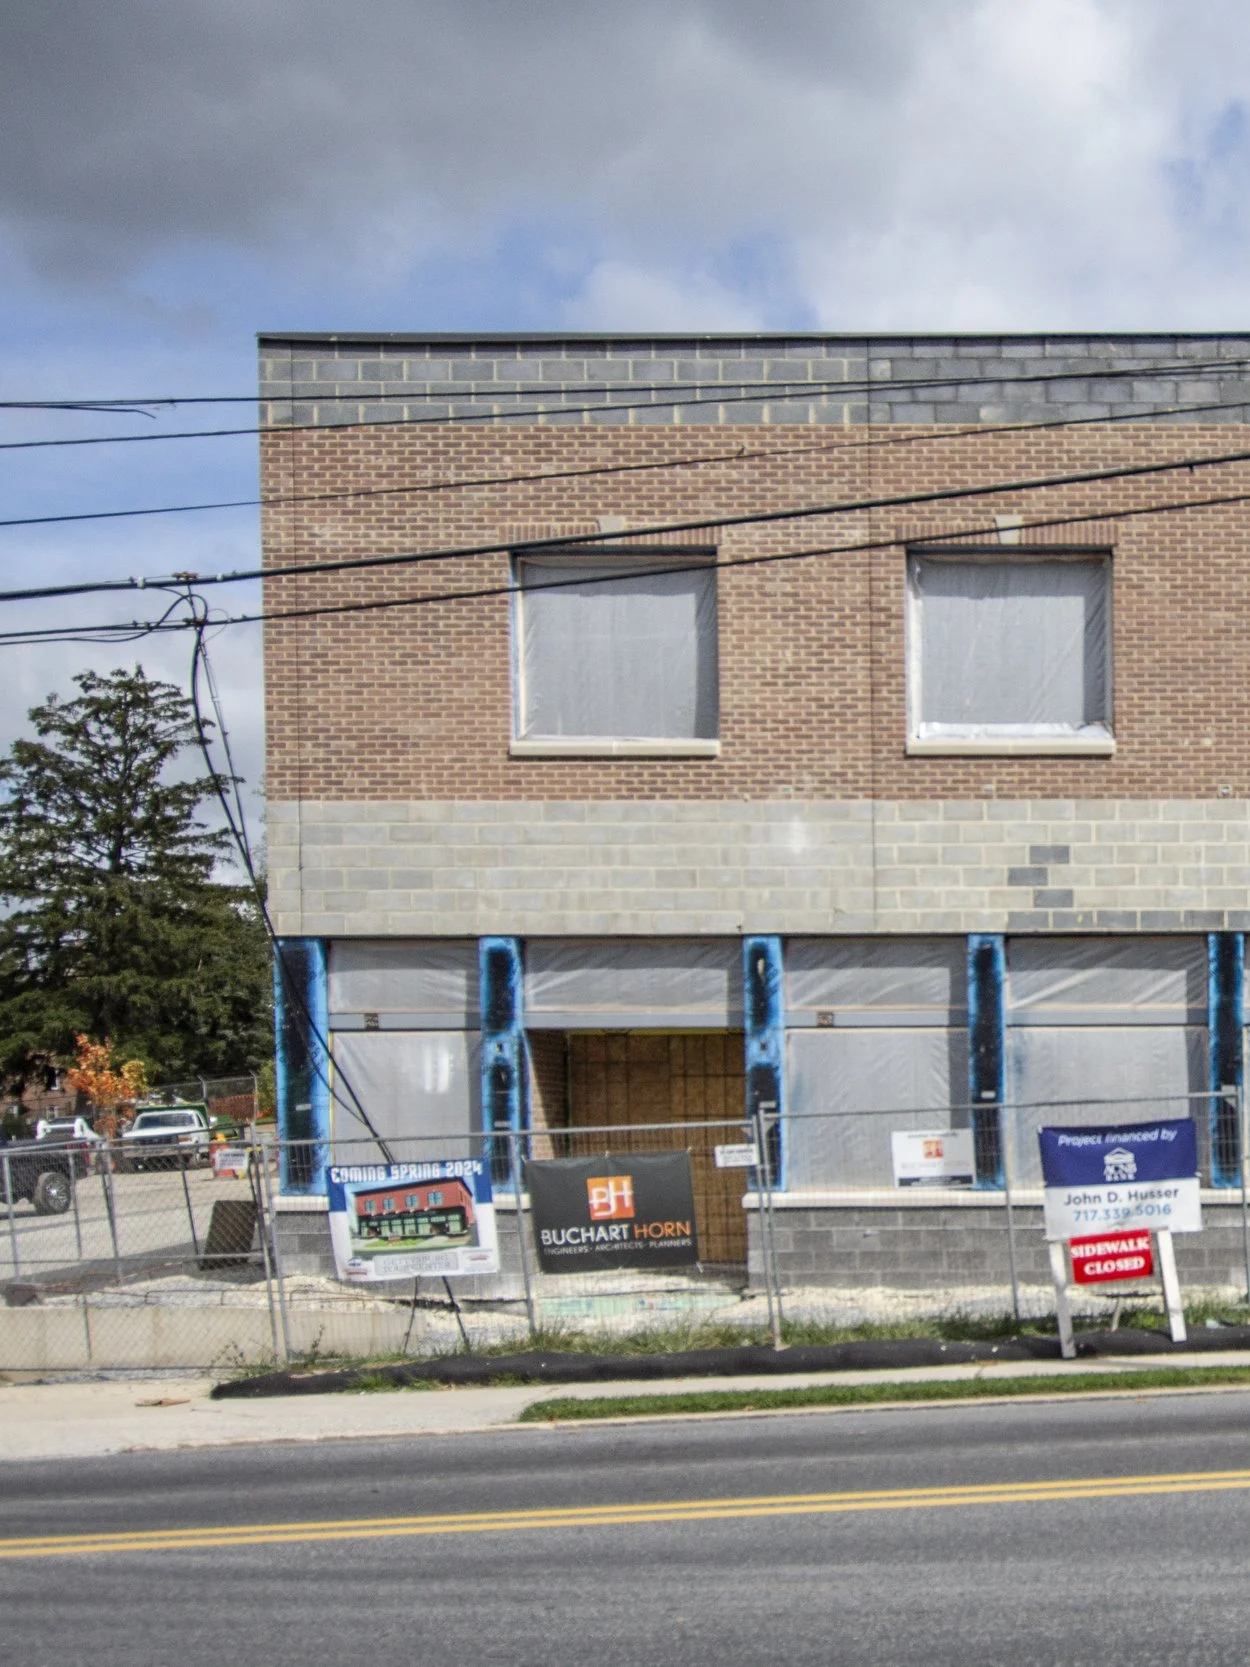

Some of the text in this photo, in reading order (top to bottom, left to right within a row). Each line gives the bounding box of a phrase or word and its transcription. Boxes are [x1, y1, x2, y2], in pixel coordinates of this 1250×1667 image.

[1058, 1133, 1102, 1148] Project
[1160, 1127, 1178, 1142] by
[331, 1160, 483, 1183] COMING SPRING 2024
[1064, 1188, 1180, 1206] John D. Husser
[540, 1220, 692, 1245] BUCHART HORN
[544, 1237, 692, 1256] ENGINEERS ARCHITECTS PLANNERS
[1070, 1236, 1150, 1258] SIDEWALK
[1083, 1256, 1145, 1276] CLOSED
